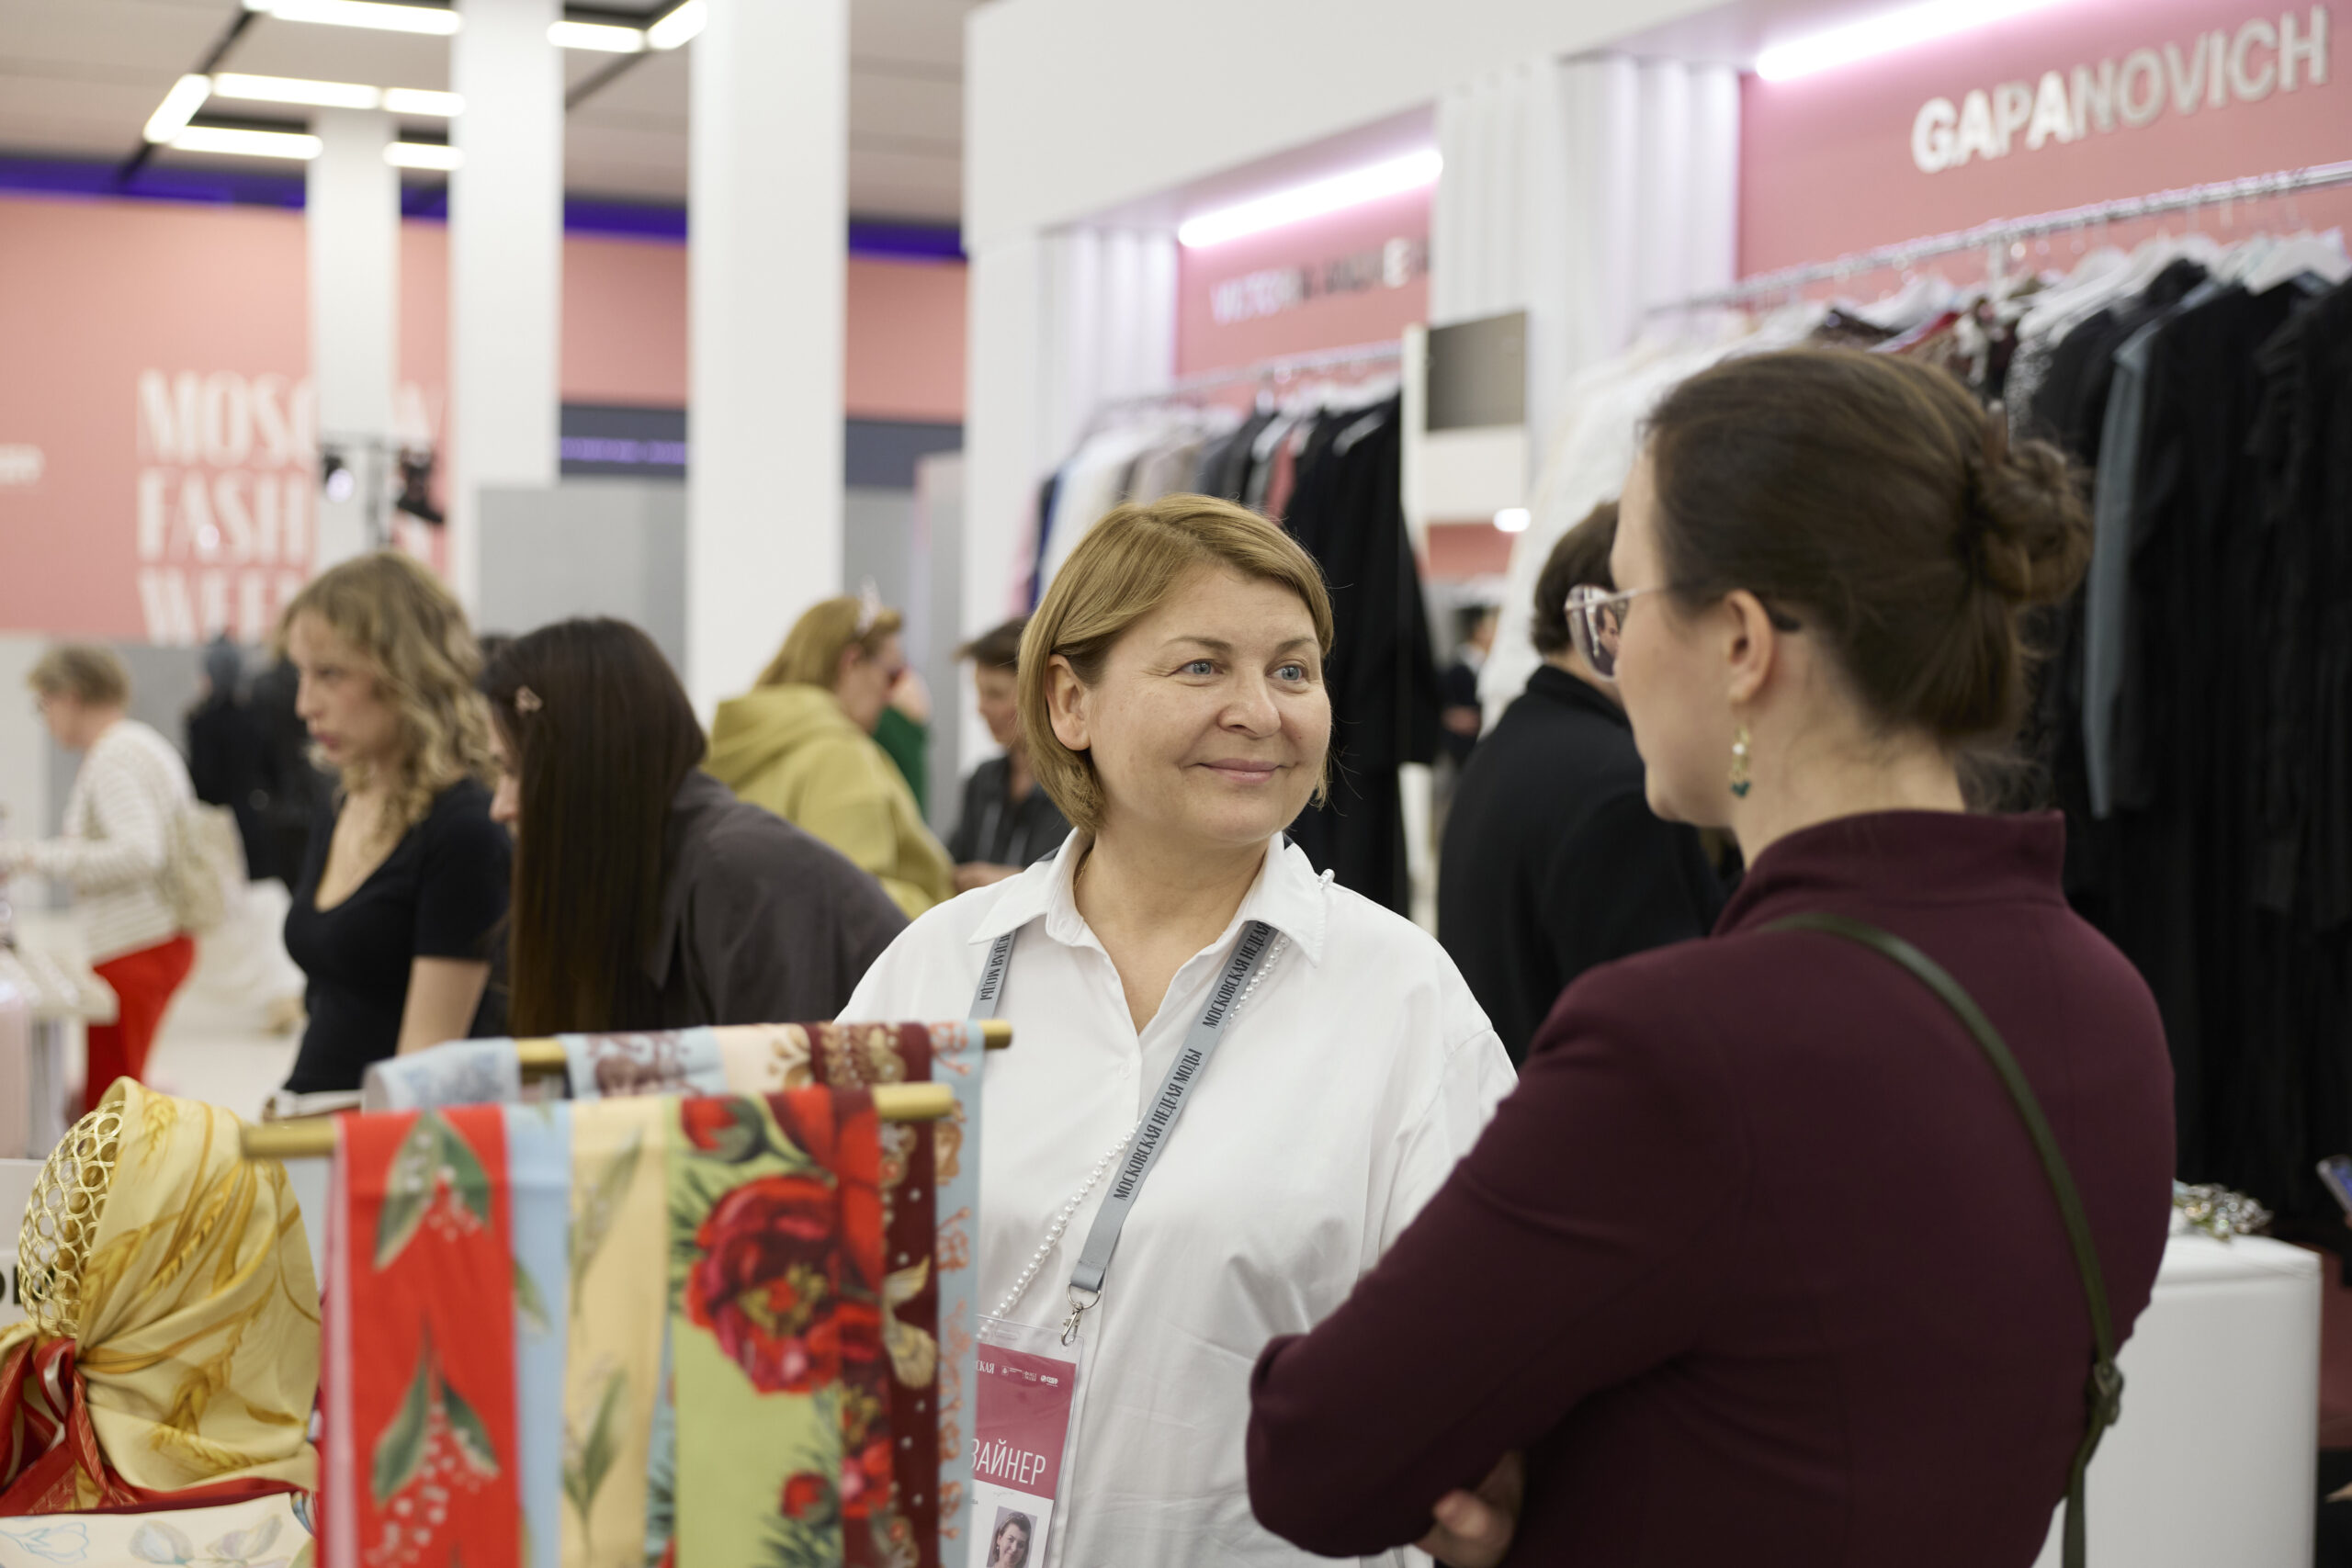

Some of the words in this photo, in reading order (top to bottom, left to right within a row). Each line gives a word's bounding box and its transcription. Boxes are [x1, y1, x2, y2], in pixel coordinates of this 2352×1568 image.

[1911, 4, 2329, 174] GAPANOVICH
[140, 368, 447, 467] MOSCW
[140, 564, 307, 646] WEE
[979, 968, 1001, 1000] МОДЫ
[1202, 958, 1250, 1029] МОСКОВСКАЯ
[1239, 921, 1272, 961] НЕДЕЛЯ
[1114, 1123, 1162, 1201] МОСКОВСКАЯ
[1151, 1083, 1184, 1126] НЕДЕЛЯ
[1173, 1048, 1203, 1085] МОДЫ
[977, 1360, 995, 1375] СКАЯ
[971, 1438, 1046, 1485] ЗАЙНЕР
